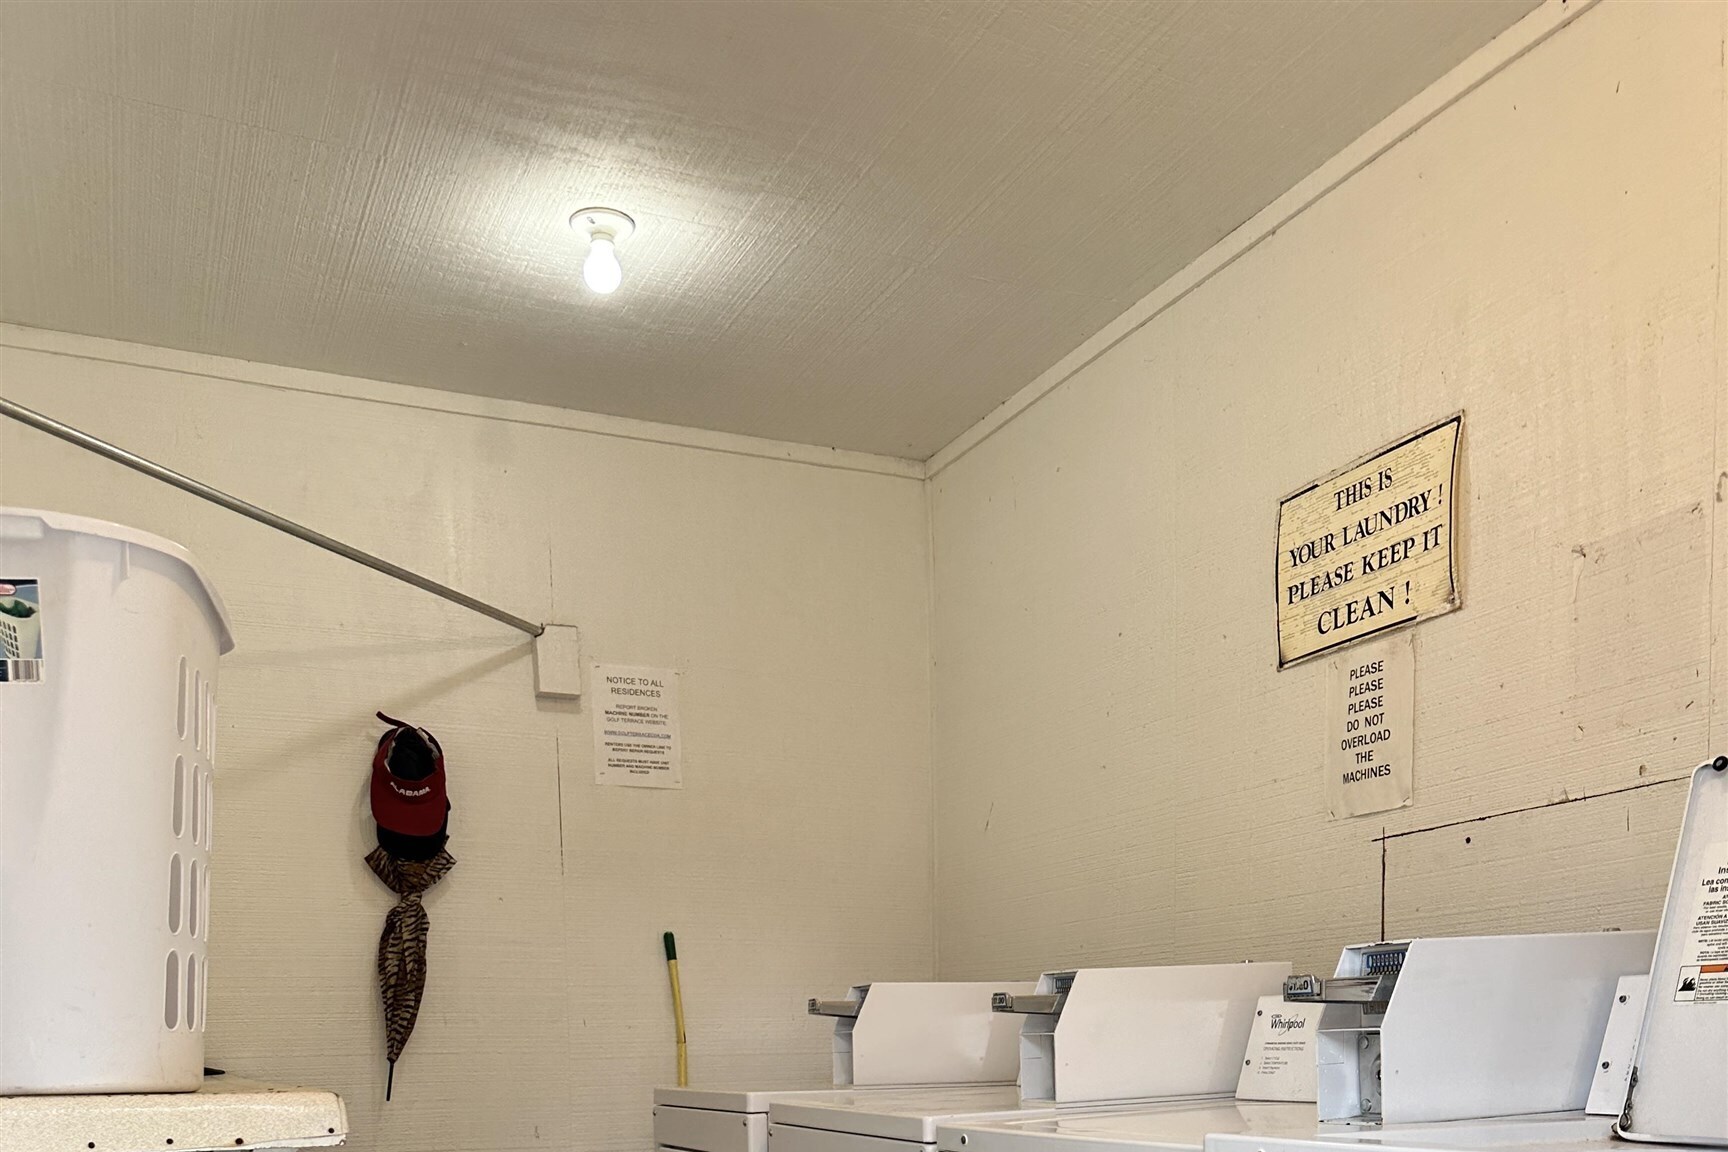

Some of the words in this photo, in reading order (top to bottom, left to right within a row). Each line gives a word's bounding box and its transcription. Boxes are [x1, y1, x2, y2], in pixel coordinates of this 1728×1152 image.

[1334, 477, 1372, 511] THIS
[1378, 467, 1393, 491] IS
[1289, 533, 1336, 567] YOUR
[1287, 561, 1354, 605] PLEASE
[1361, 537, 1416, 576] KEEP
[1422, 523, 1443, 553] IT
[1317, 586, 1395, 635] CLEAN
[1349, 660, 1385, 681] PLEASE
[606, 676, 636, 686] NOTICE
[638, 678, 649, 687] TO
[650, 680, 665, 688] ALL
[1348, 678, 1384, 698] PLEASE
[610, 687, 662, 698] RESIDENCES
[1347, 695, 1384, 715] PLEASE
[1346, 719, 1360, 733] DO
[1364, 712, 1385, 728] NOT
[1341, 729, 1391, 751] OVERLOAD
[1355, 750, 1374, 765] THE
[1342, 764, 1392, 784] MACHINES
[1702, 878, 1715, 886] Lea
[1708, 885, 1719, 893] las
[1271, 1018, 1306, 1031] Whirlpool
